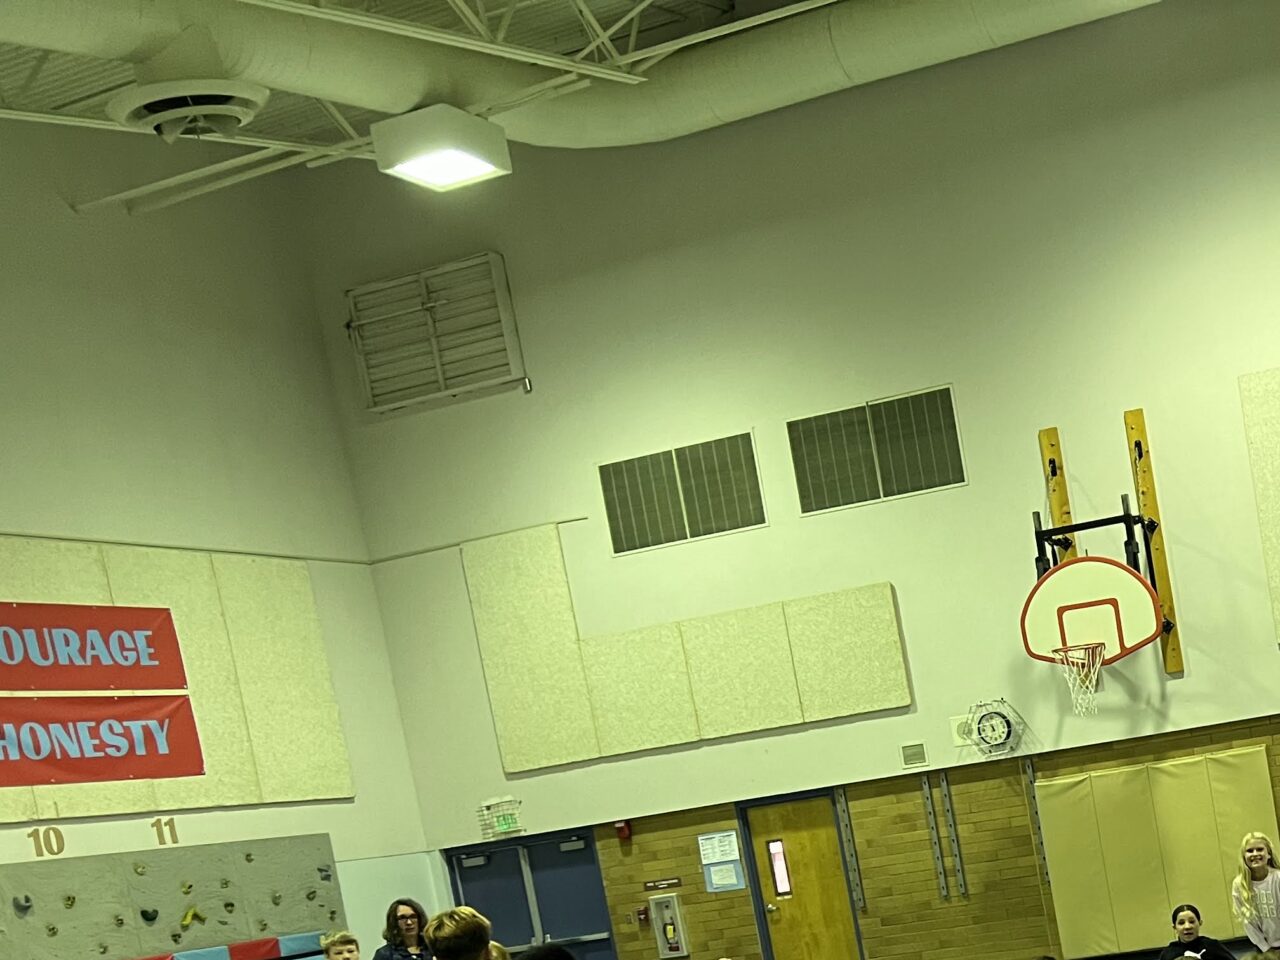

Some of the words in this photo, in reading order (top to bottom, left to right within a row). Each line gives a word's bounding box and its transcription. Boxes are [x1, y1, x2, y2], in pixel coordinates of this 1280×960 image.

[0, 717, 171, 761] HONESTY
[26, 826, 66, 858] 10
[150, 816, 180, 846] 11
